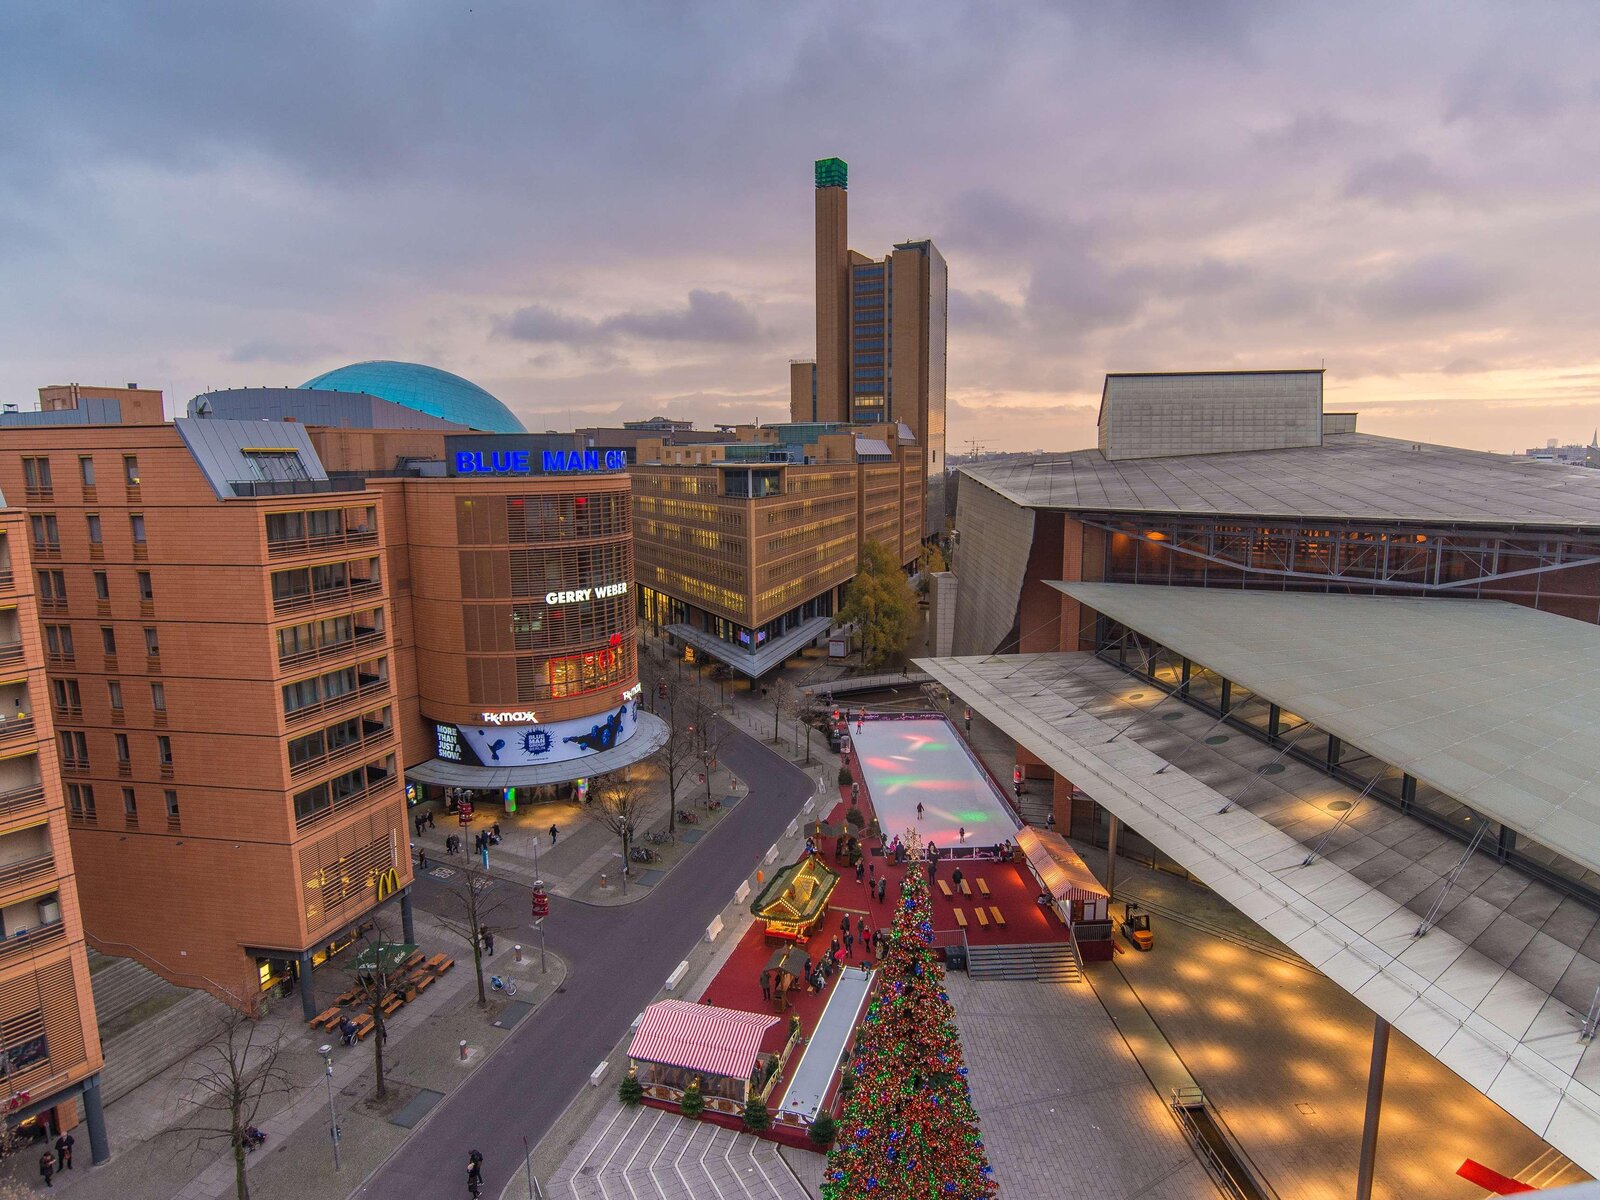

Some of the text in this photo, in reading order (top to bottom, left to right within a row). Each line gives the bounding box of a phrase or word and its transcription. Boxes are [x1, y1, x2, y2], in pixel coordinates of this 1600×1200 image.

[456, 450, 530, 473] BLUE
[543, 450, 599, 472] MAN
[545, 582, 628, 605] GERRY WEBER
[437, 724, 457, 736] MORE
[437, 732, 457, 744] THAN
[439, 741, 462, 753] JUST A
[439, 749, 462, 761] SHOW.
